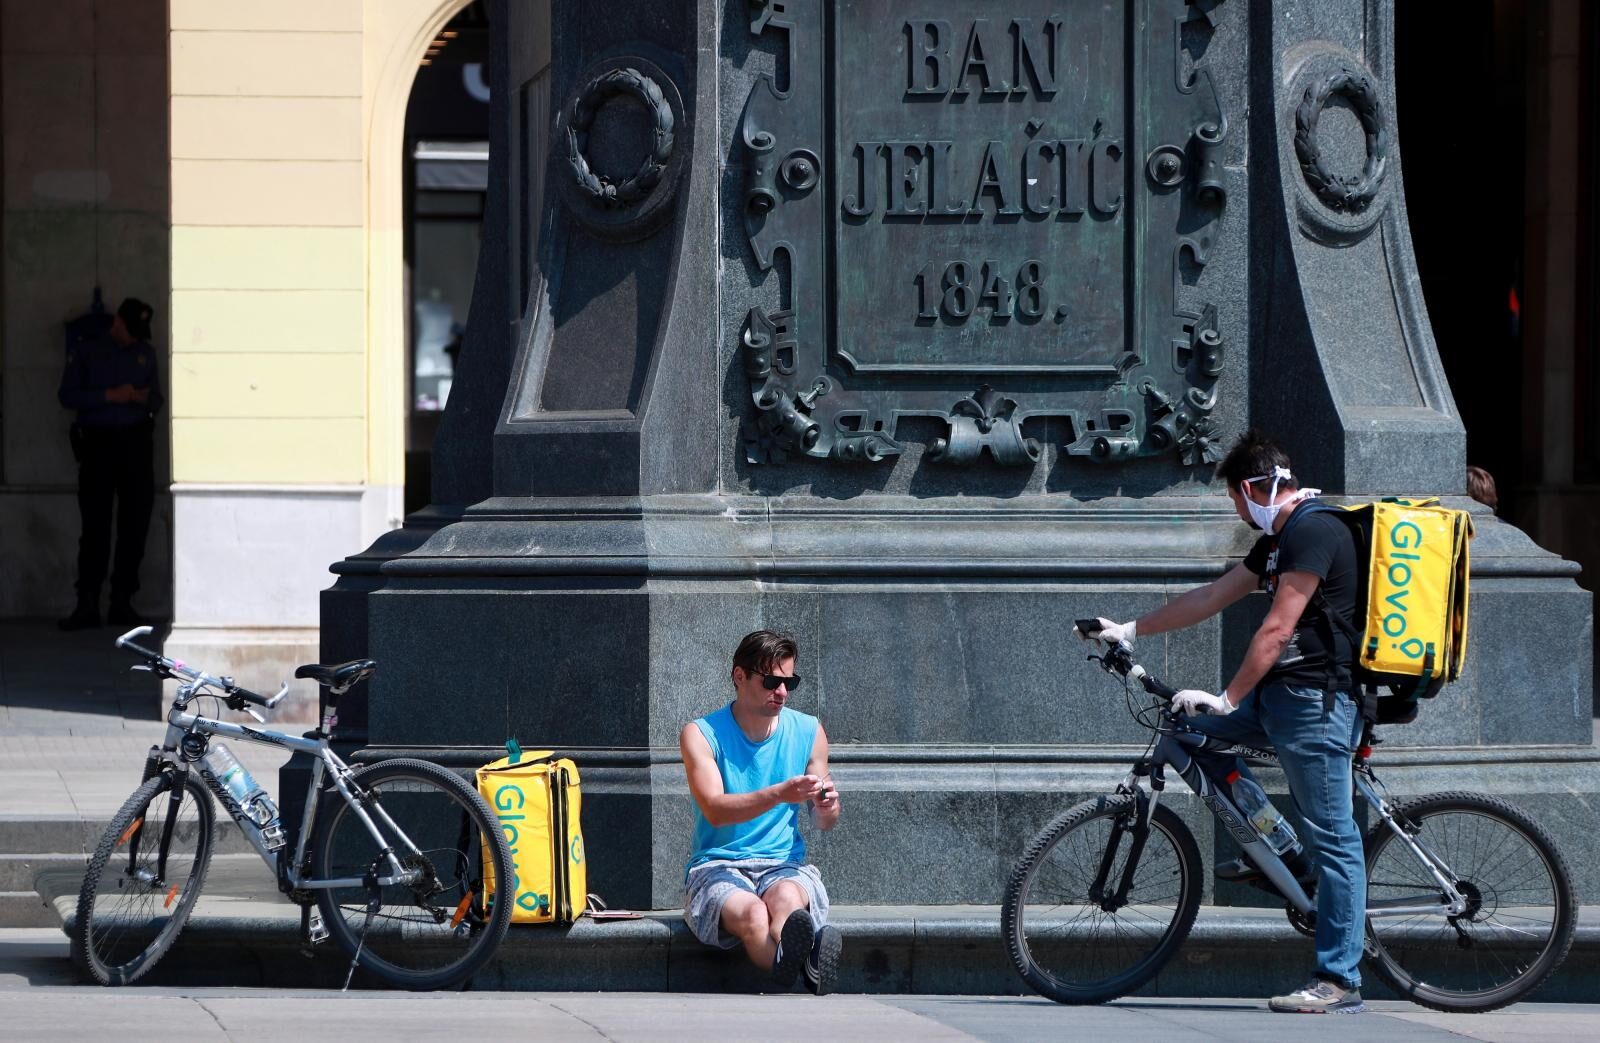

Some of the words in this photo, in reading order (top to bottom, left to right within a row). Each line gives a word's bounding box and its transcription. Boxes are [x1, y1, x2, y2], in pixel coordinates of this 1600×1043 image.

[904, 18, 1062, 102] BAN
[842, 117, 1124, 224] JELAČIĆ
[914, 259, 1070, 326] 1848.
[494, 784, 526, 892] Glo
